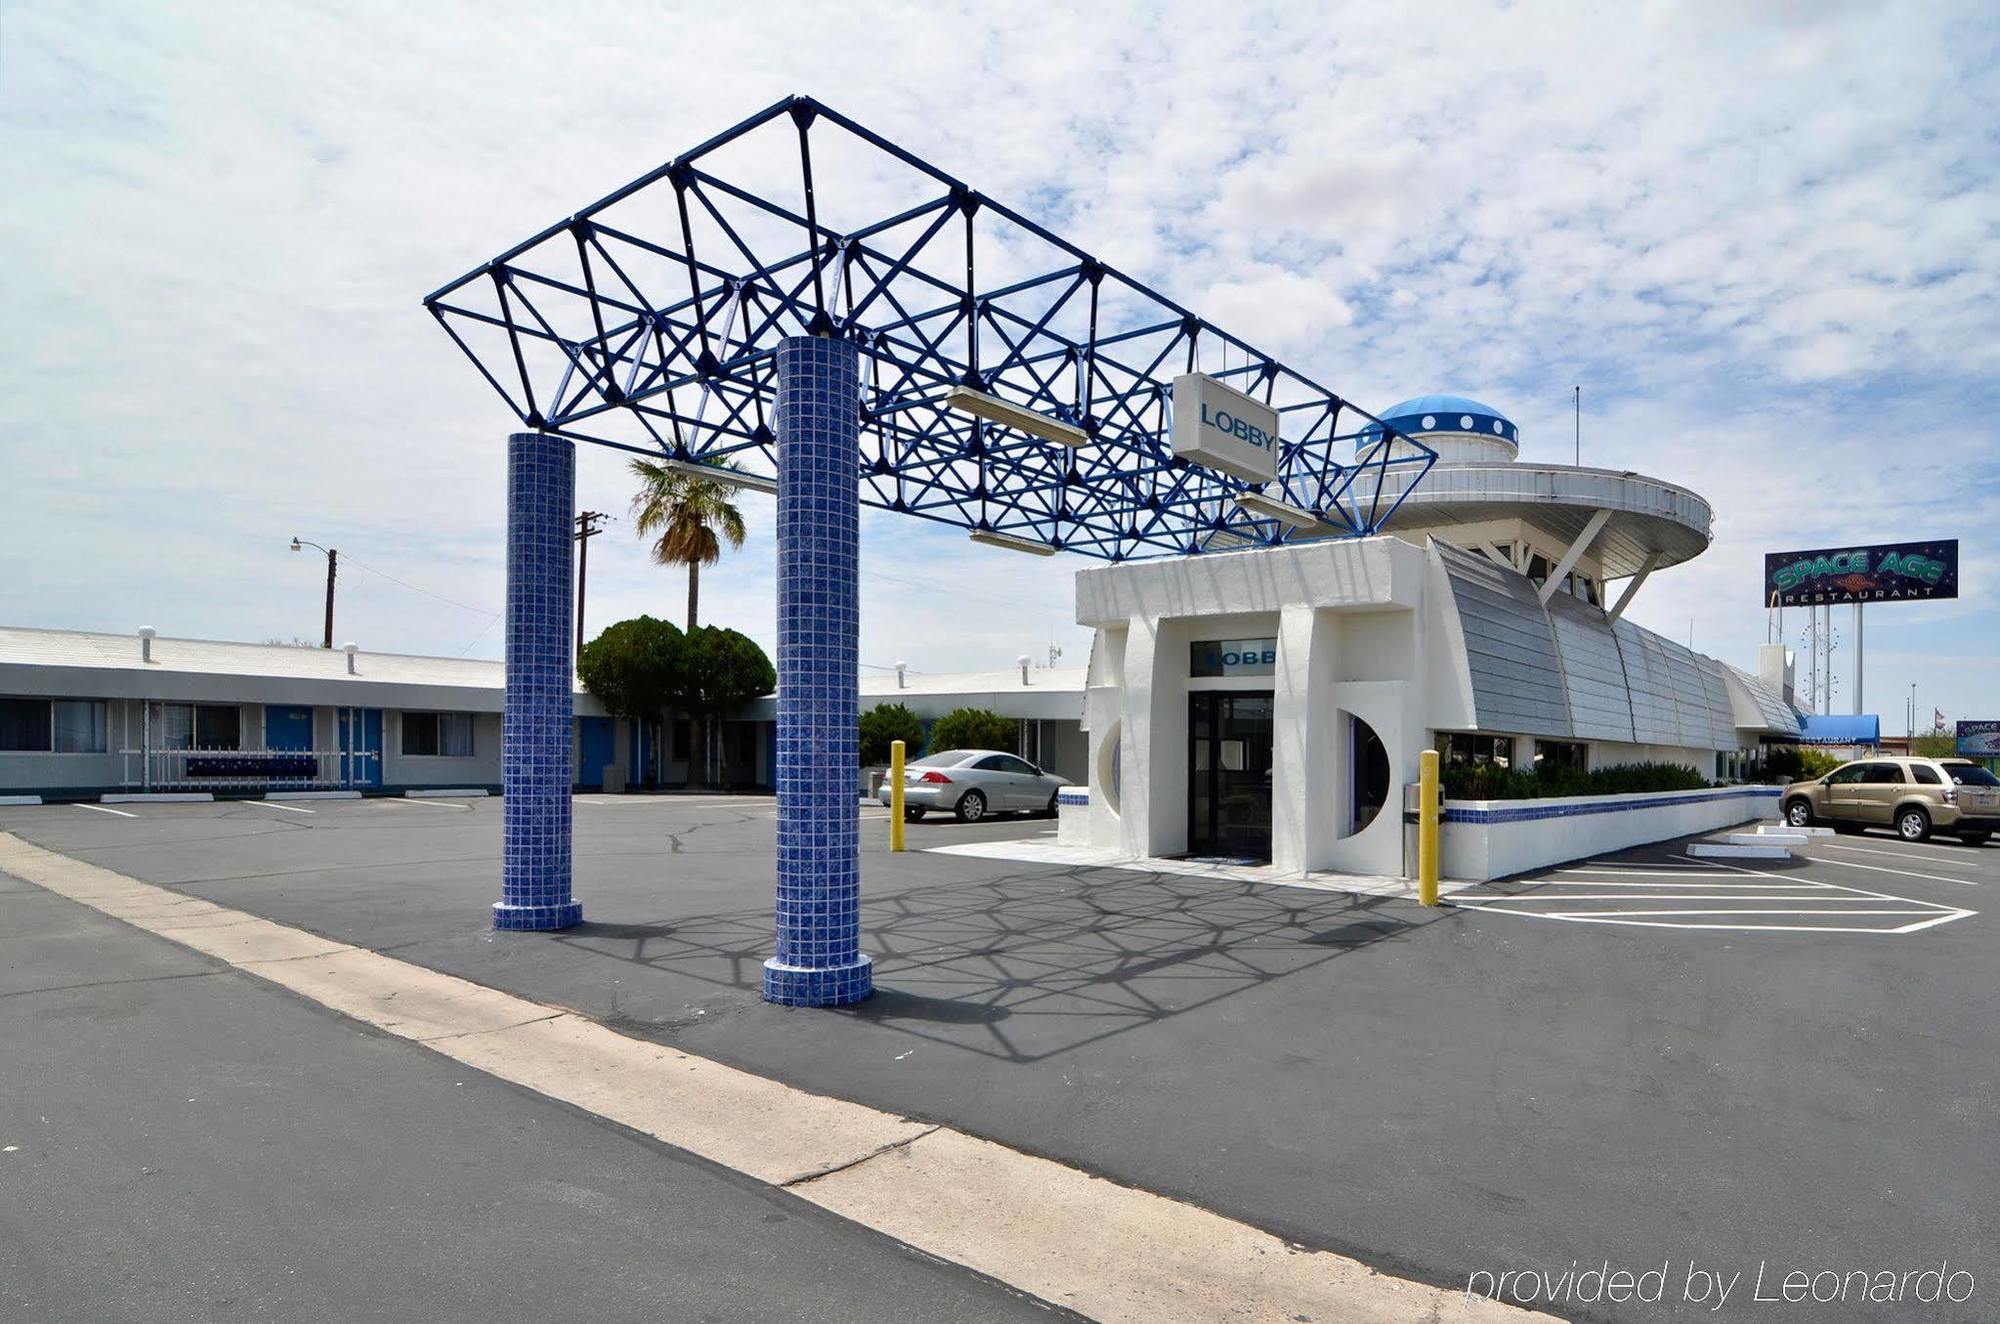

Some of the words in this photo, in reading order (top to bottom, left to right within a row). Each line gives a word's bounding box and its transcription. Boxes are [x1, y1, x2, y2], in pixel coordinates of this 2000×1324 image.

[1201, 403, 1275, 452] LOBBY
[1772, 550, 1870, 592] SPACE
[1877, 551, 1946, 586] AGE
[1786, 587, 1934, 603] RESTAURANT
[1206, 650, 1276, 667] LOBB
